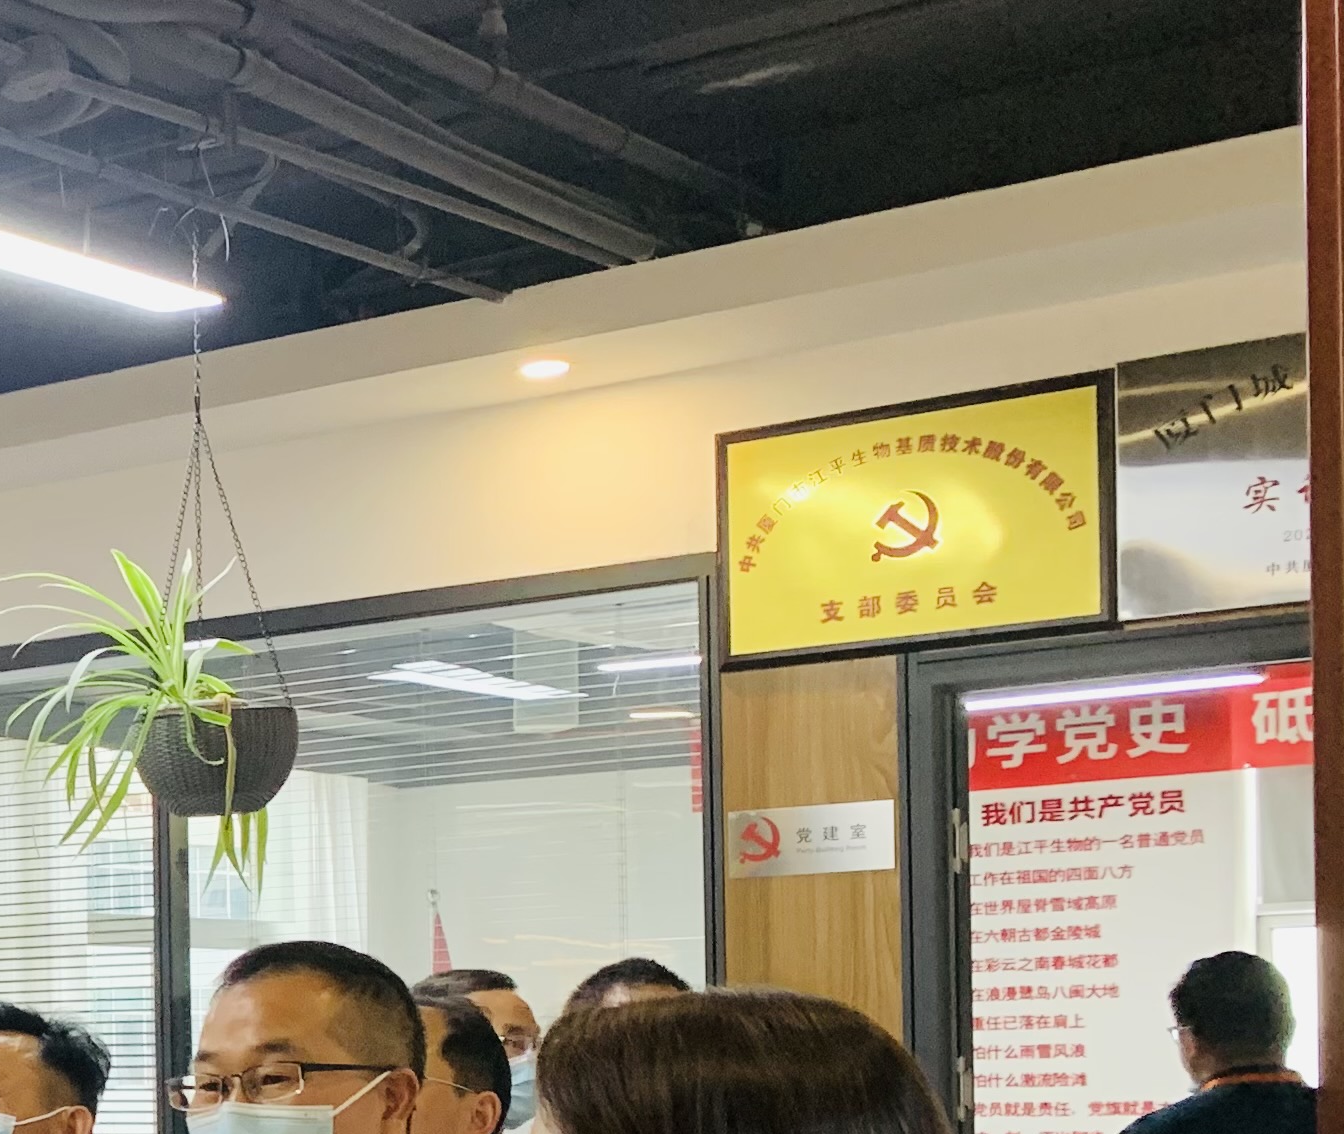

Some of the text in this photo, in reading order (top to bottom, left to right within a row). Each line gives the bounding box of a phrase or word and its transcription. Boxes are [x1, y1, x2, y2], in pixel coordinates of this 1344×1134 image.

[820, 581, 998, 624] 支部委员会
[981, 789, 1185, 827] 我们是共产党员
[796, 823, 868, 844] 党建室
